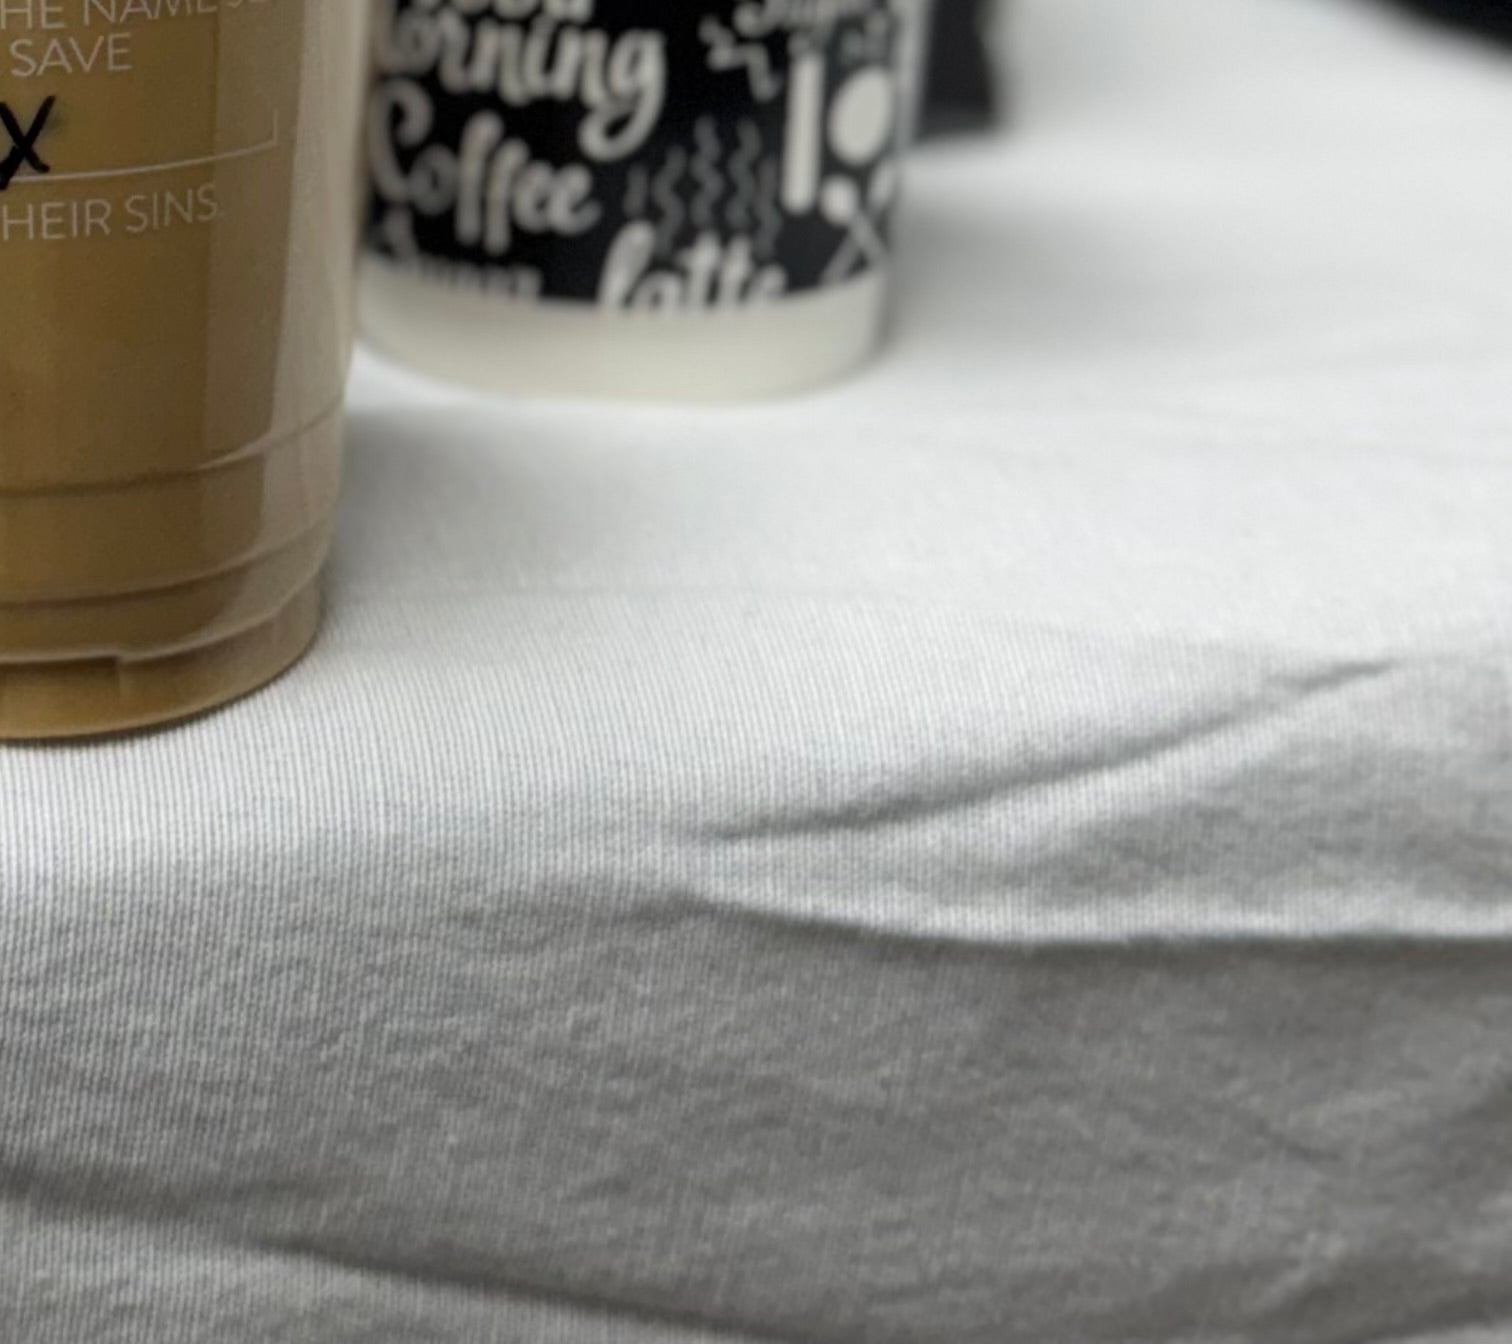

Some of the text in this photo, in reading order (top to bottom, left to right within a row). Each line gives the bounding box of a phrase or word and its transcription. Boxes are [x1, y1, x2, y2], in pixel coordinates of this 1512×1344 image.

[9, 30, 134, 77] SAVE
[374, 9, 667, 162] orning
[370, 78, 604, 256] Coffee
